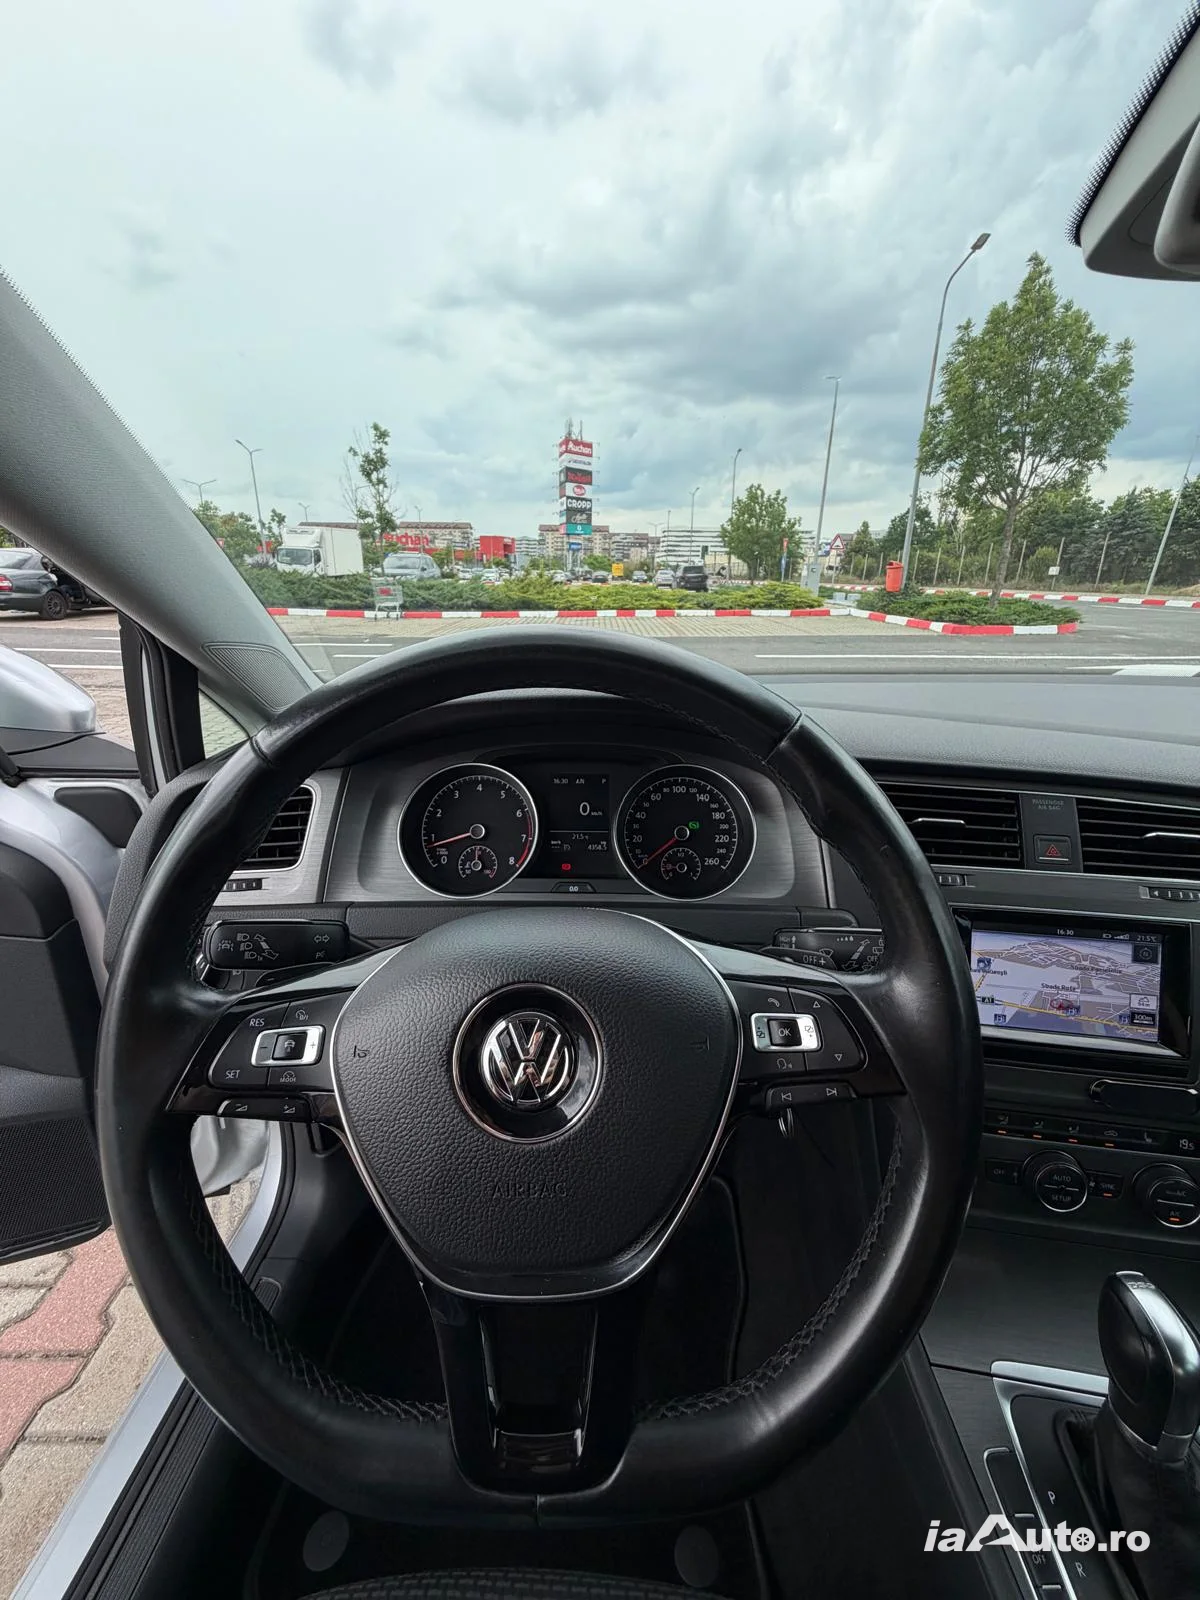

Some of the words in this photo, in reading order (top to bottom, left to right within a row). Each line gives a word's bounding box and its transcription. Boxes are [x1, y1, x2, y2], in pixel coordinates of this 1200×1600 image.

[567, 441, 592, 454] Auchan
[567, 499, 592, 509] CROPP
[476, 783, 483, 792] 4
[672, 785, 687, 793] 100
[453, 790, 460, 799] 3
[500, 790, 506, 799] 5
[650, 792, 662, 801] 60
[696, 793, 710, 802] 140
[436, 808, 442, 817] 2
[579, 801, 590, 816] 0
[516, 809, 522, 818] 6
[635, 811, 646, 820] 40
[711, 811, 726, 820] 180
[521, 834, 527, 843] 7
[632, 834, 643, 843] 20
[714, 834, 730, 843] 220
[440, 855, 448, 864] 0
[508, 856, 515, 865] 8
[704, 857, 720, 866] 260
[802, 954, 818, 962] OFF
[866, 955, 878, 963] OFF
[249, 1017, 265, 1026] RES
[778, 1028, 792, 1037] OK
[225, 1069, 241, 1079] SET
[1052, 1174, 1072, 1182] AUTO
[492, 1182, 568, 1198] AIRBAG
[1047, 1490, 1056, 1505] P
[1075, 1561, 1086, 1577] R
